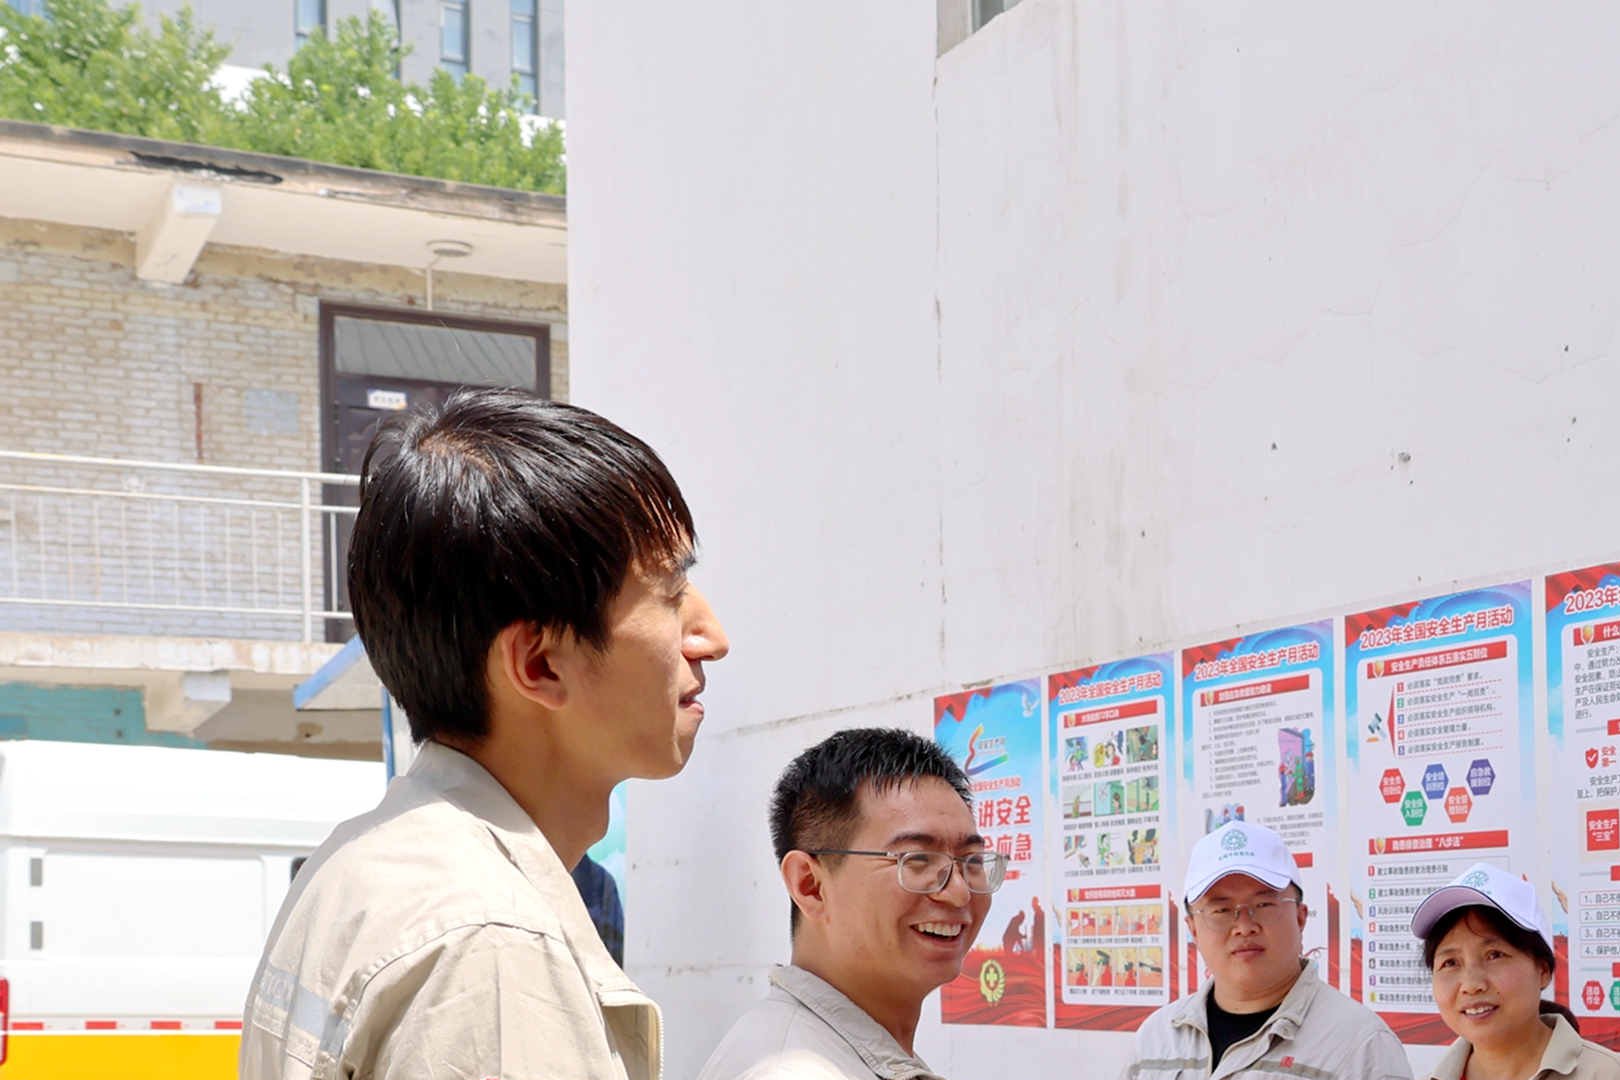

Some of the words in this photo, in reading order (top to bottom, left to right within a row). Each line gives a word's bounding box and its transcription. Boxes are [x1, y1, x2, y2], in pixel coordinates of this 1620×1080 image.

[1361, 607, 1513, 648] 2023年全国安全生产月活动
[1195, 643, 1319, 680] 2023年全国安全生产月活动
[1060, 671, 1161, 703] 2023年全国安全生产月活动
[978, 796, 1031, 827] 讲安全
